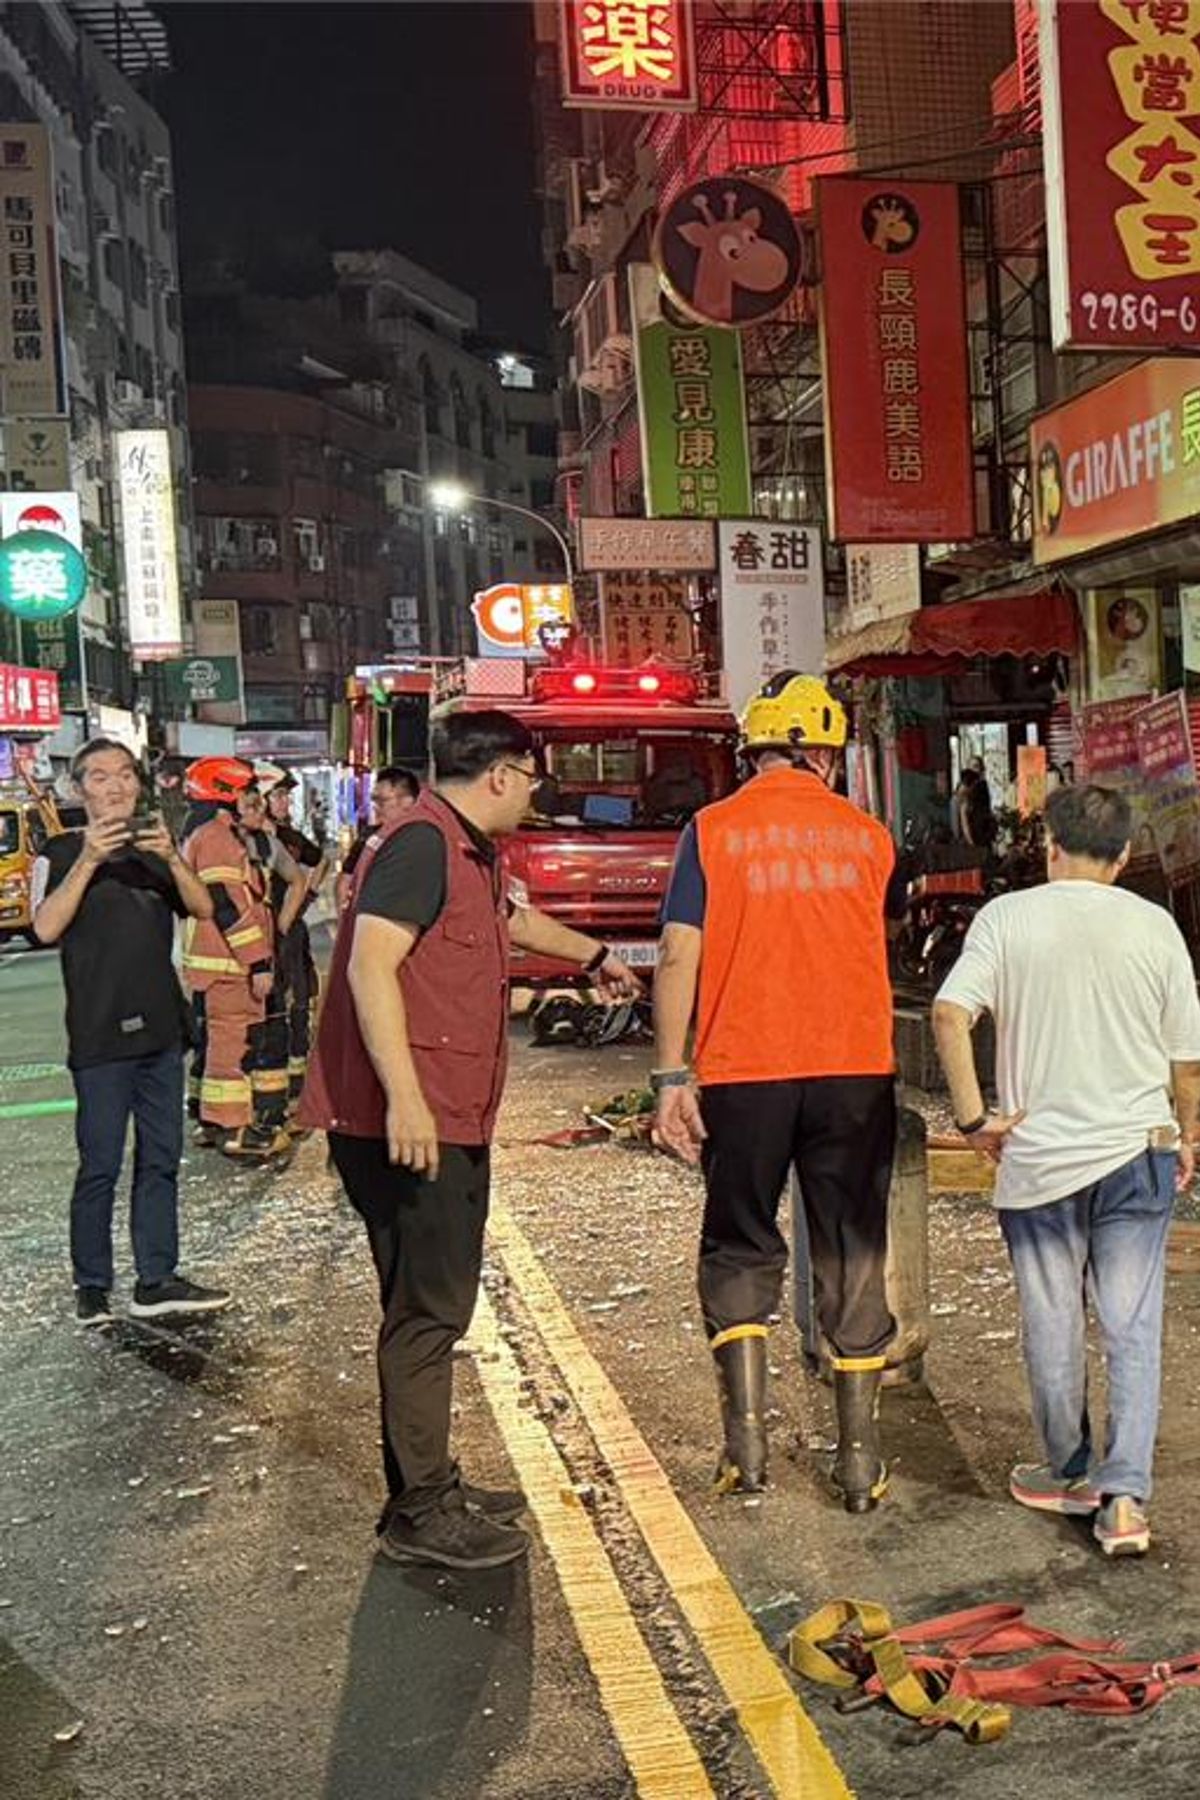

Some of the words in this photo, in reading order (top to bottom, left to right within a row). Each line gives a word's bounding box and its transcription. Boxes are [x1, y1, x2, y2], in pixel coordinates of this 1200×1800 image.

[603, 83, 657, 99] DRUG
[669, 335, 719, 468] 愛見康
[877, 268, 923, 483] 長頸鹿美語
[1065, 409, 1177, 508] GIRAFFE
